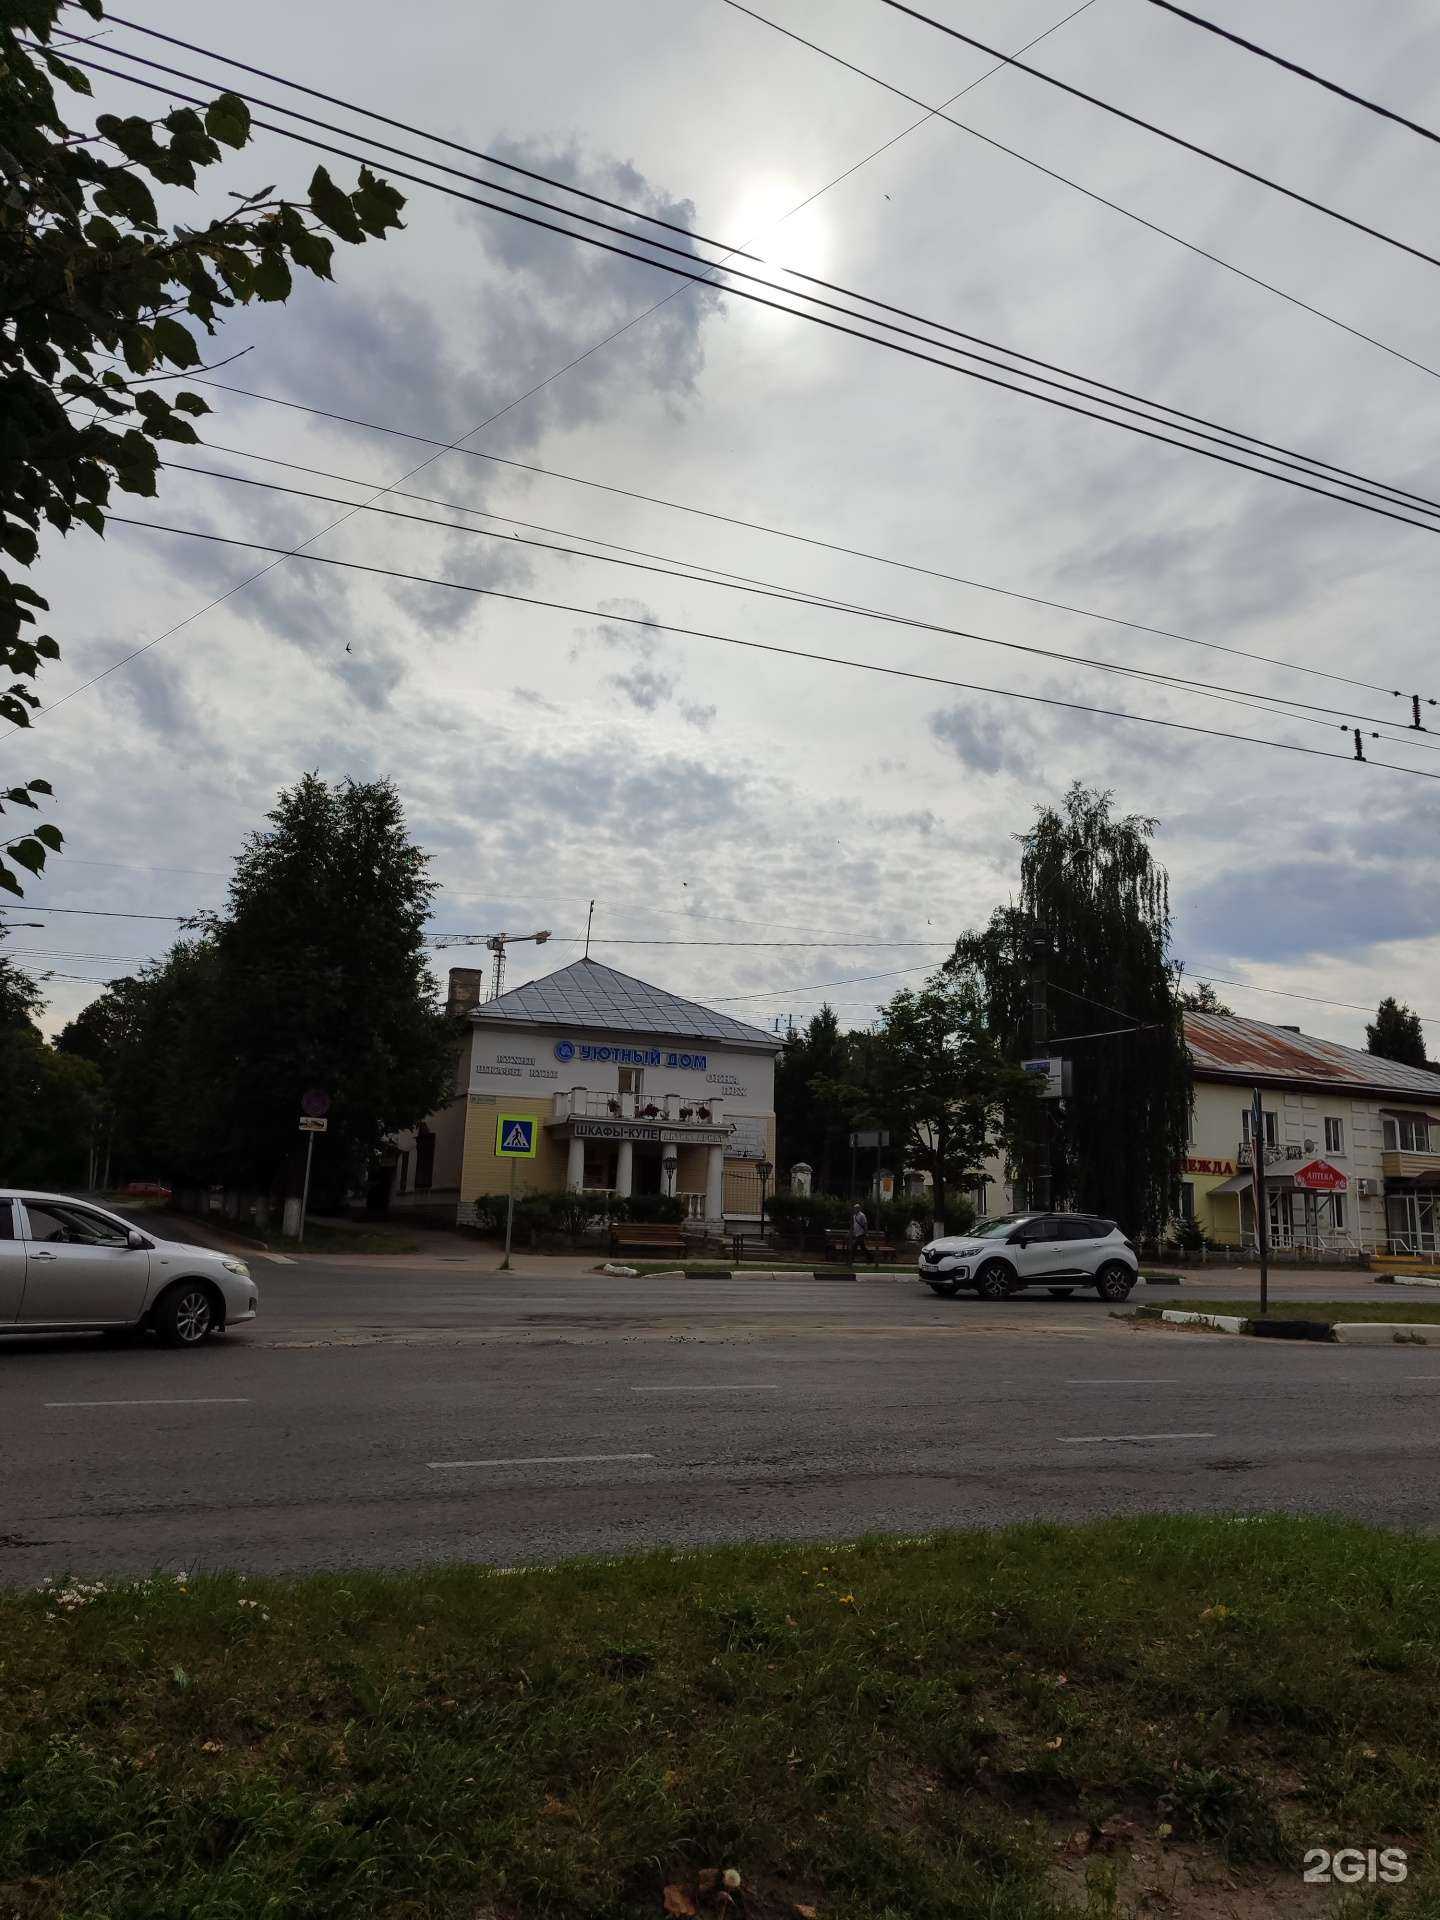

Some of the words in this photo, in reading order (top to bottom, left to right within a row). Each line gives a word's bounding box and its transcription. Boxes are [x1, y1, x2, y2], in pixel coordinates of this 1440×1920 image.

[579, 1044, 661, 1065] УЮТНЫЙ
[666, 1052, 708, 1071] ДОМ
[575, 1124, 659, 1140] ШКАФЫ-КУПЕ
[1306, 1171, 1334, 1182] АПТЕКА
